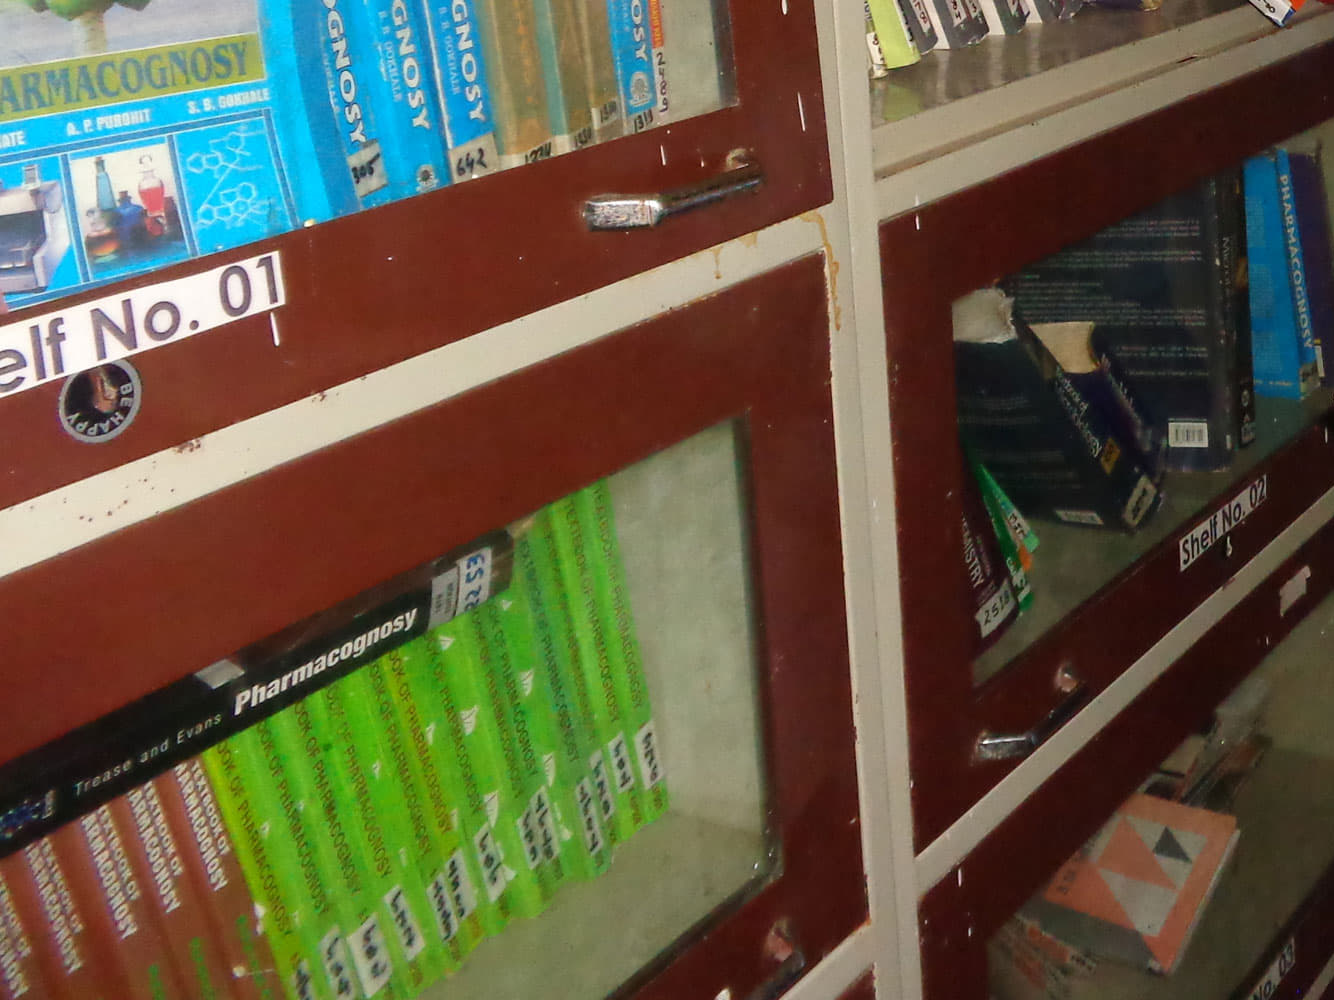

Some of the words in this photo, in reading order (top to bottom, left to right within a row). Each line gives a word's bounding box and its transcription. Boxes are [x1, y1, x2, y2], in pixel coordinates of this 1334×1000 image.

[90, 298, 200, 361] No.
[219, 255, 279, 317] 01
[1280, 174, 1314, 350] PHARMACOGNOSY
[65, 412, 125, 435] HAPPY
[120, 383, 134, 407] BE
[1182, 514, 1218, 566] Shelf
[1221, 503, 1246, 533] No.
[1249, 480, 1265, 509] 02
[73, 759, 133, 798] Trease
[140, 738, 169, 763] and
[176, 712, 222, 745] Evans
[233, 607, 418, 716] Pharmacognosy
[407, 704, 453, 836] PHARMACOGNOSY
[81, 814, 139, 941] ARMACOGNOSY
[127, 788, 182, 915] ARMACOGNOSY
